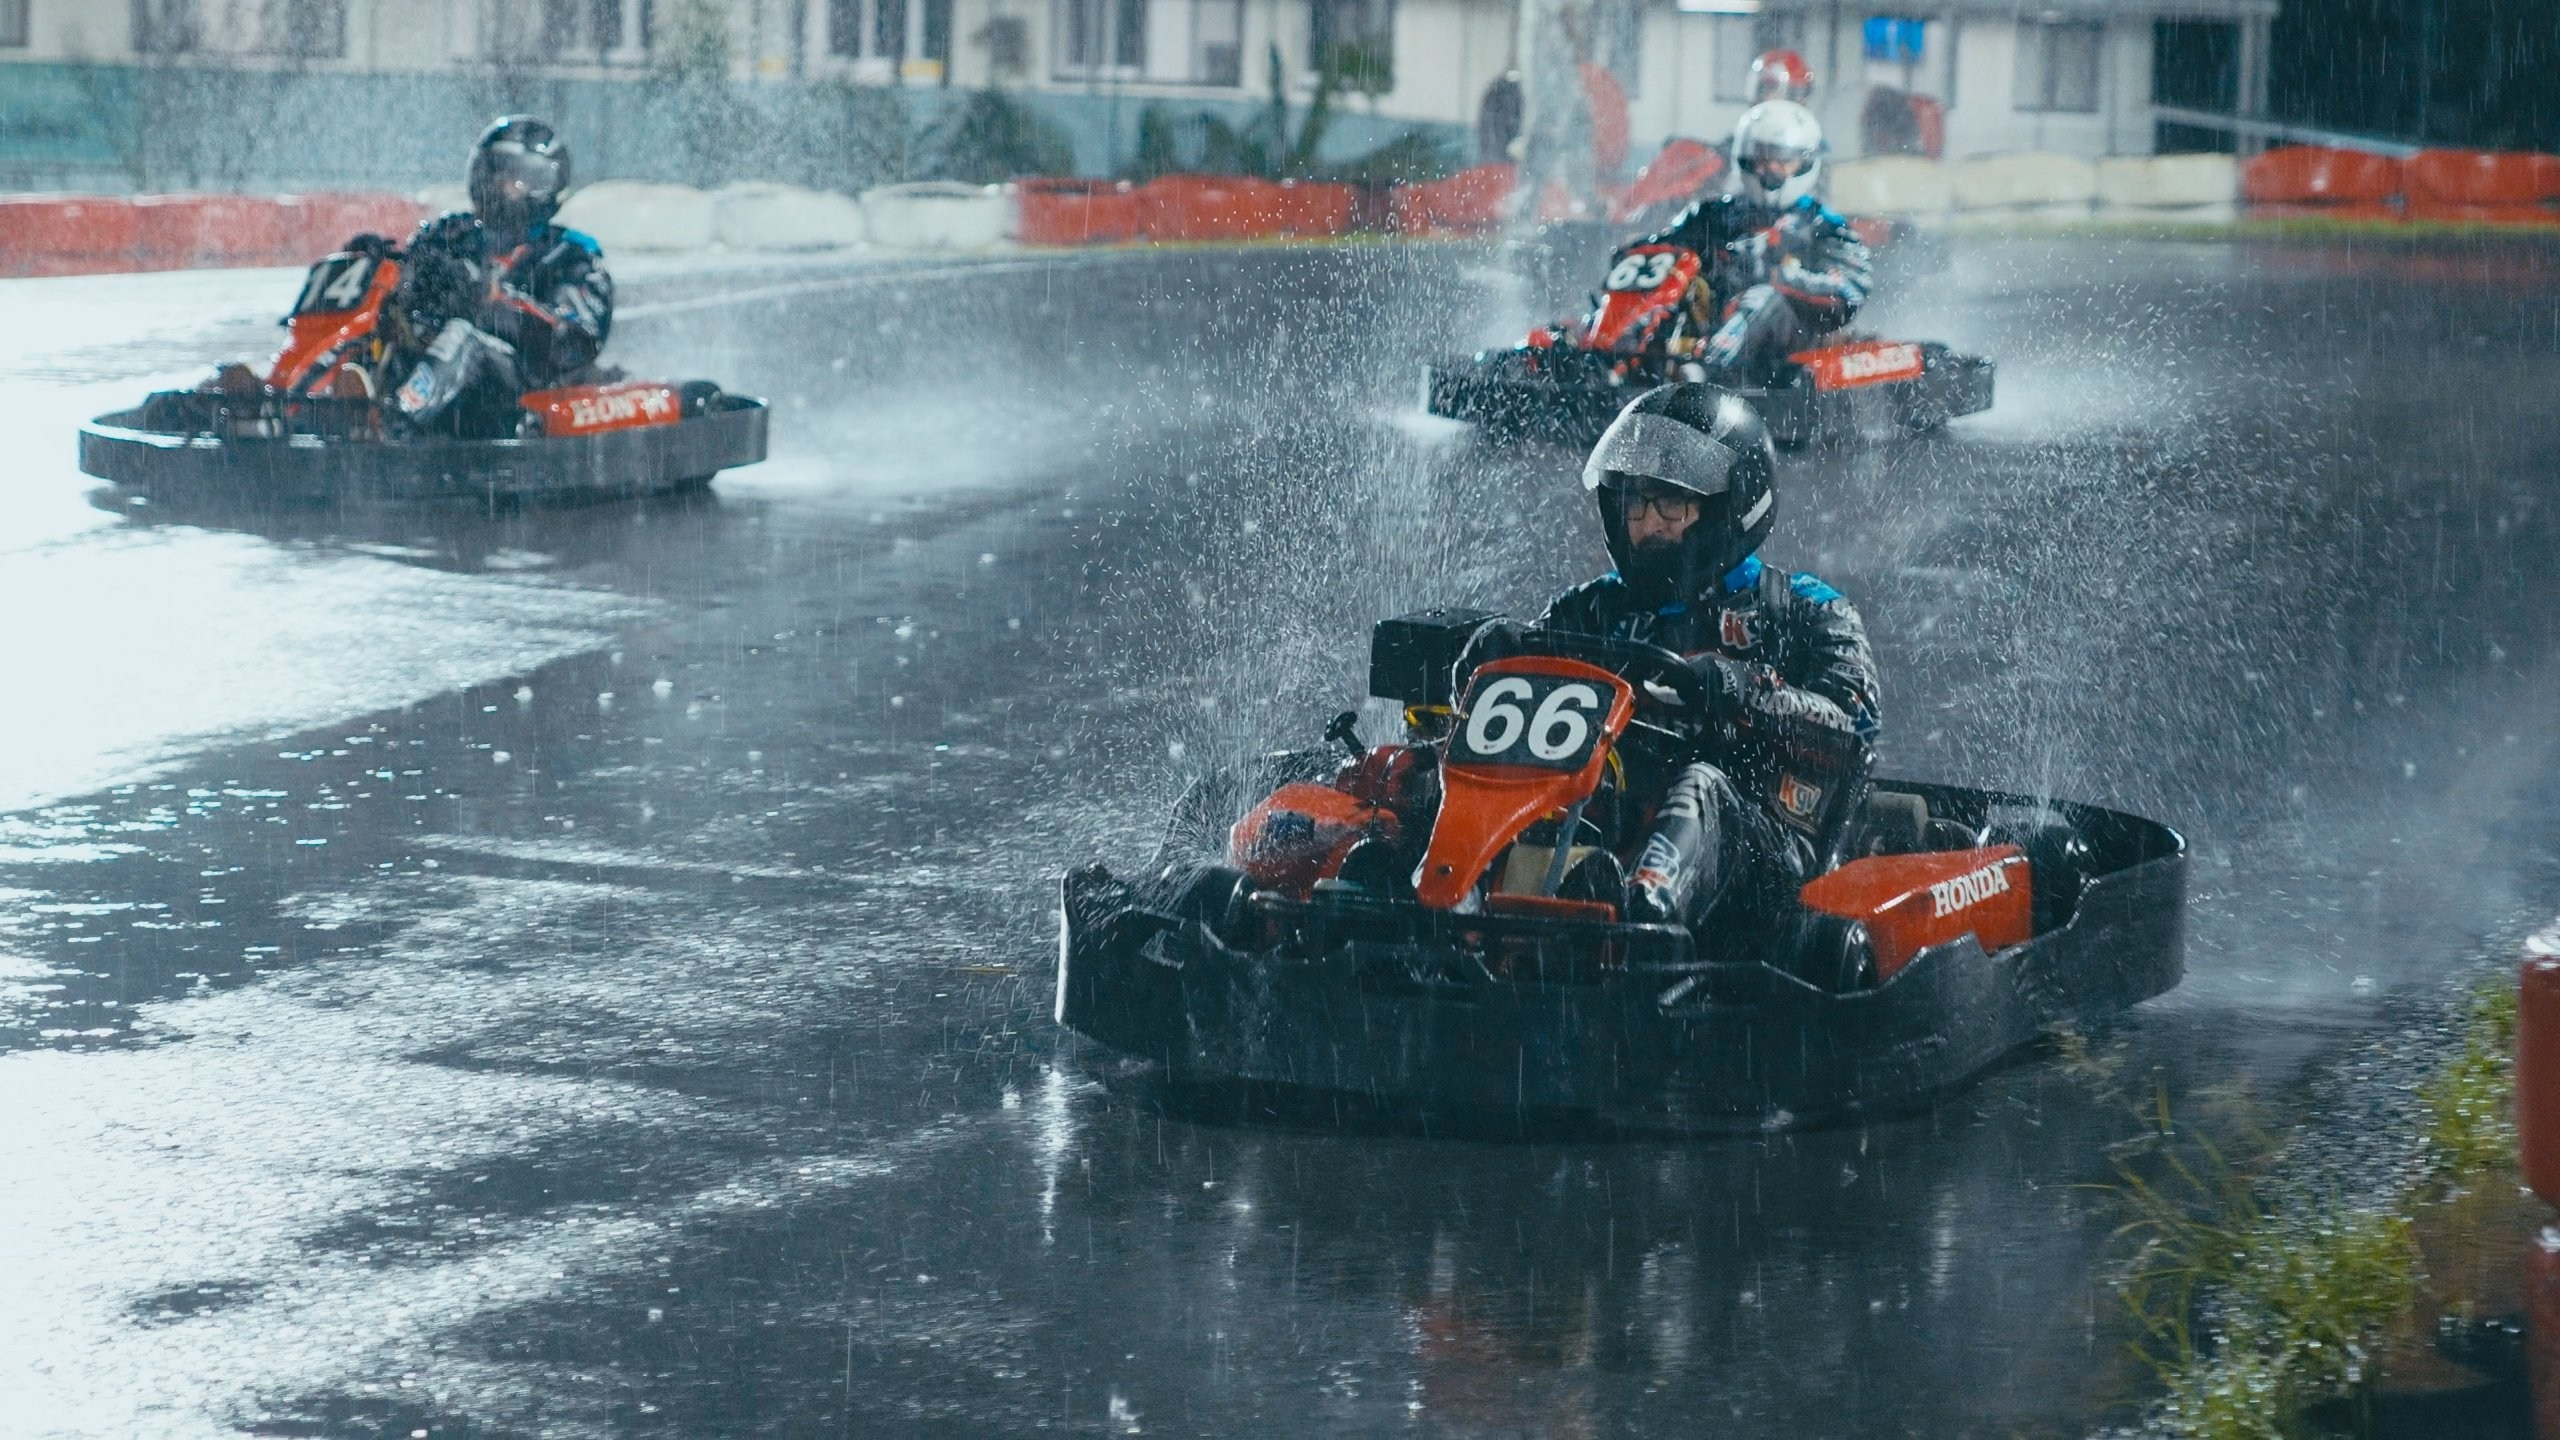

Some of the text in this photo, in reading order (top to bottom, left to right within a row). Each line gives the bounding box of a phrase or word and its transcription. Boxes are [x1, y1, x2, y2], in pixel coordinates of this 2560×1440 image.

[300, 257, 370, 310] 14
[1606, 252, 1676, 290] 63
[569, 389, 671, 427] HON
[1466, 677, 1598, 760] 66
[1930, 861, 2010, 918] HONDA
